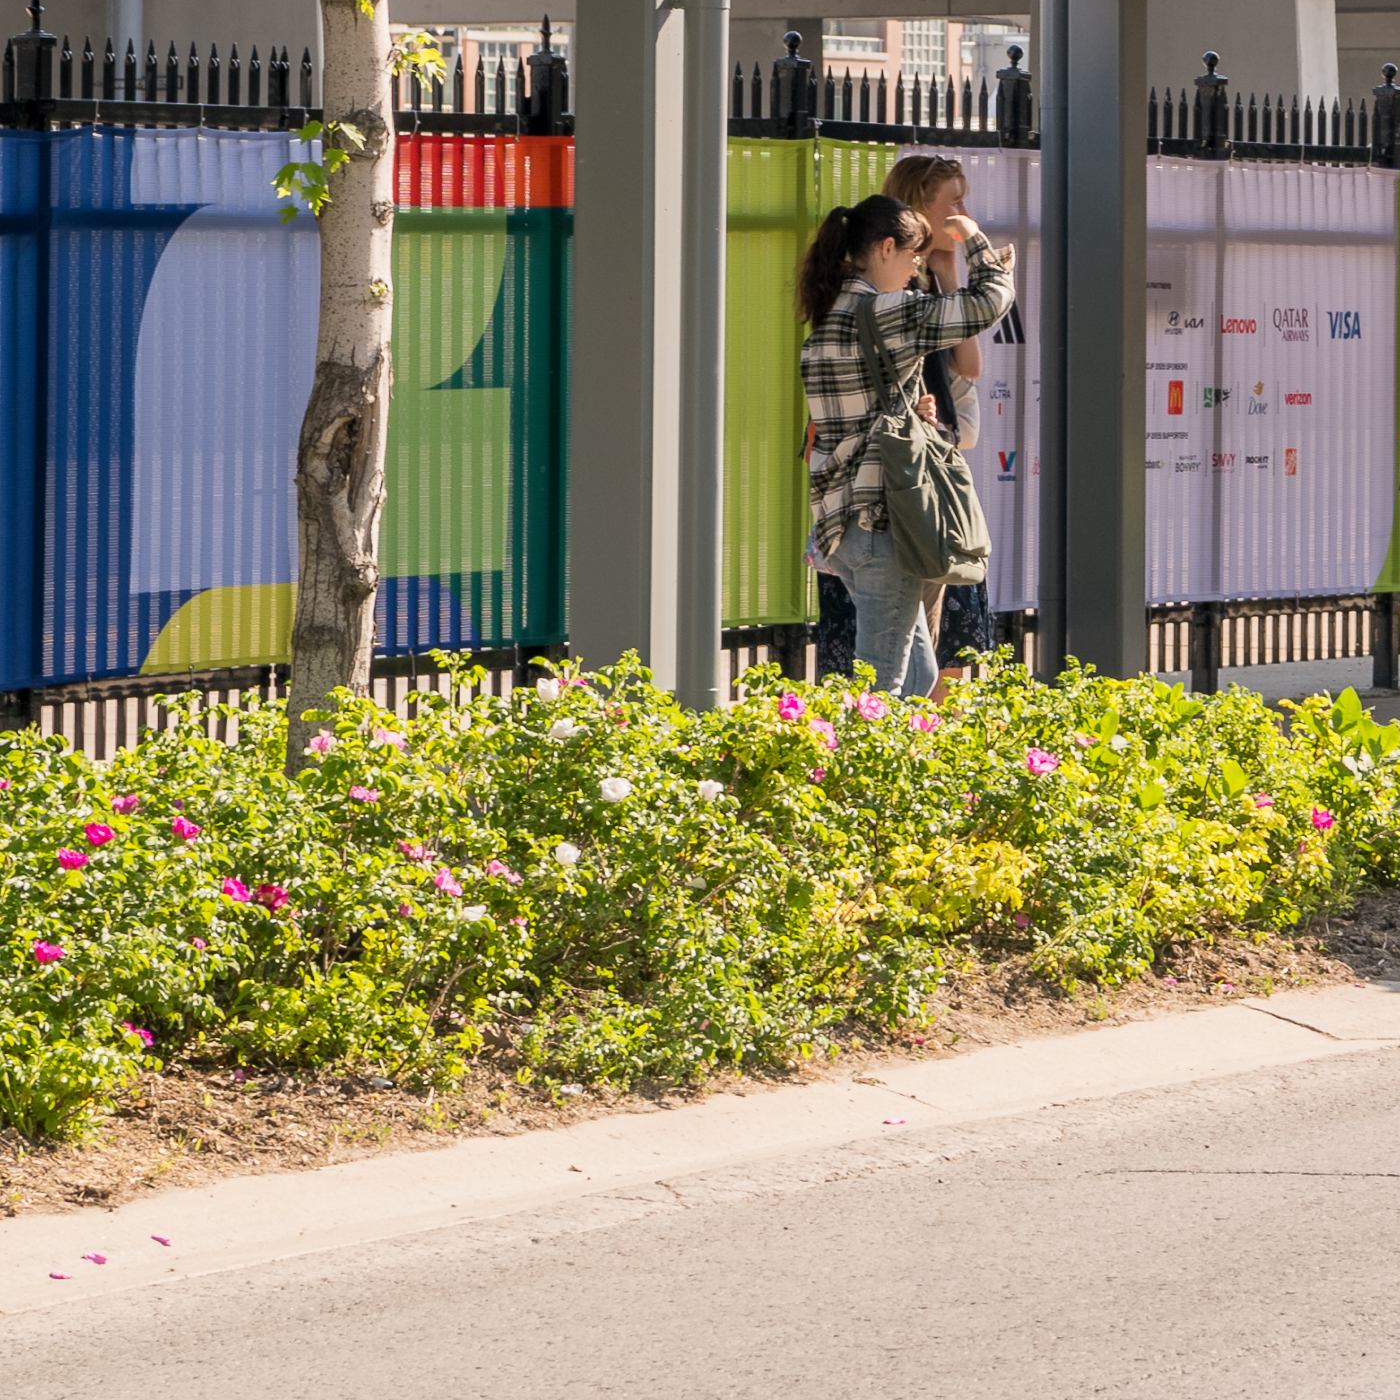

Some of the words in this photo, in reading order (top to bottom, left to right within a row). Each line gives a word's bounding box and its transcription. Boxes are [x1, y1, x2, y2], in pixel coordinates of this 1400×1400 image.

[1220, 313, 1257, 334] Lenovo
[1273, 307, 1310, 331] QATAR
[1326, 310, 1362, 340] VISA
[1281, 329, 1310, 343] AIRWAYS
[1247, 396, 1269, 416] Dove
[1284, 389, 1312, 406] verizon
